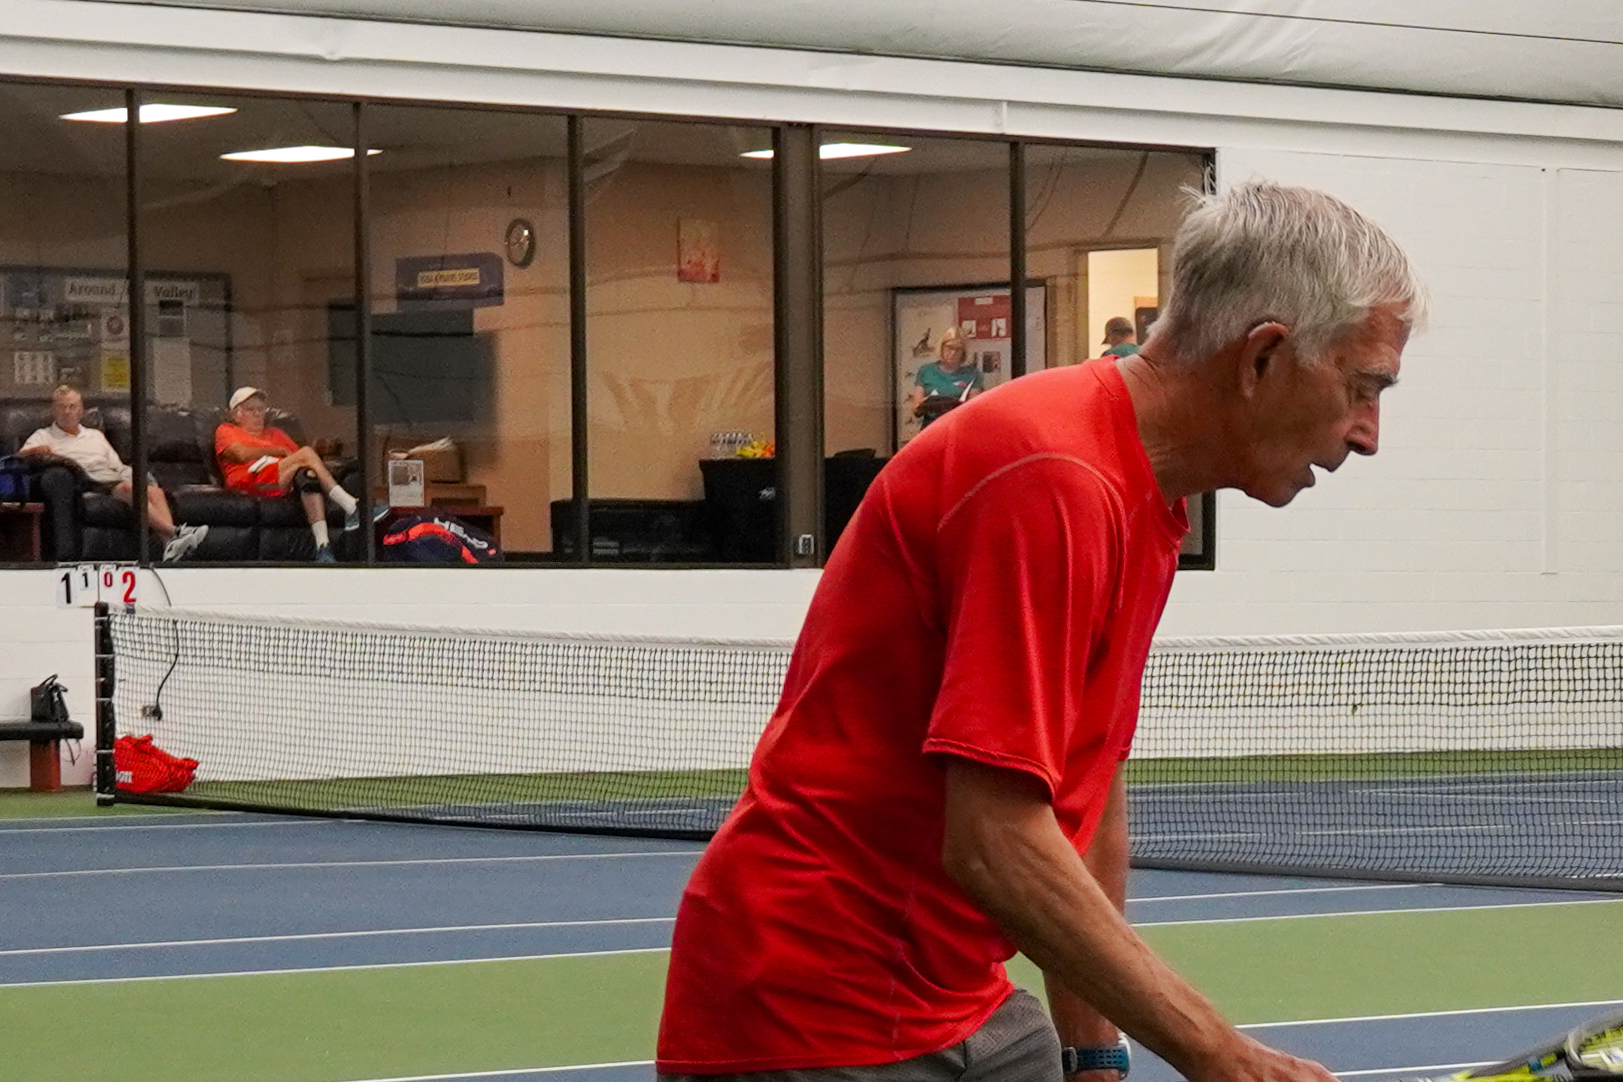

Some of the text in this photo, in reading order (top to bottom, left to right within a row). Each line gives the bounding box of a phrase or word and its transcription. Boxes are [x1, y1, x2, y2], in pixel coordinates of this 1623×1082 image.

[69, 283, 116, 296] Around
[154, 286, 194, 298] Valley
[434, 517, 489, 549] HEAD
[61, 571, 137, 604] 1 1 0 2
